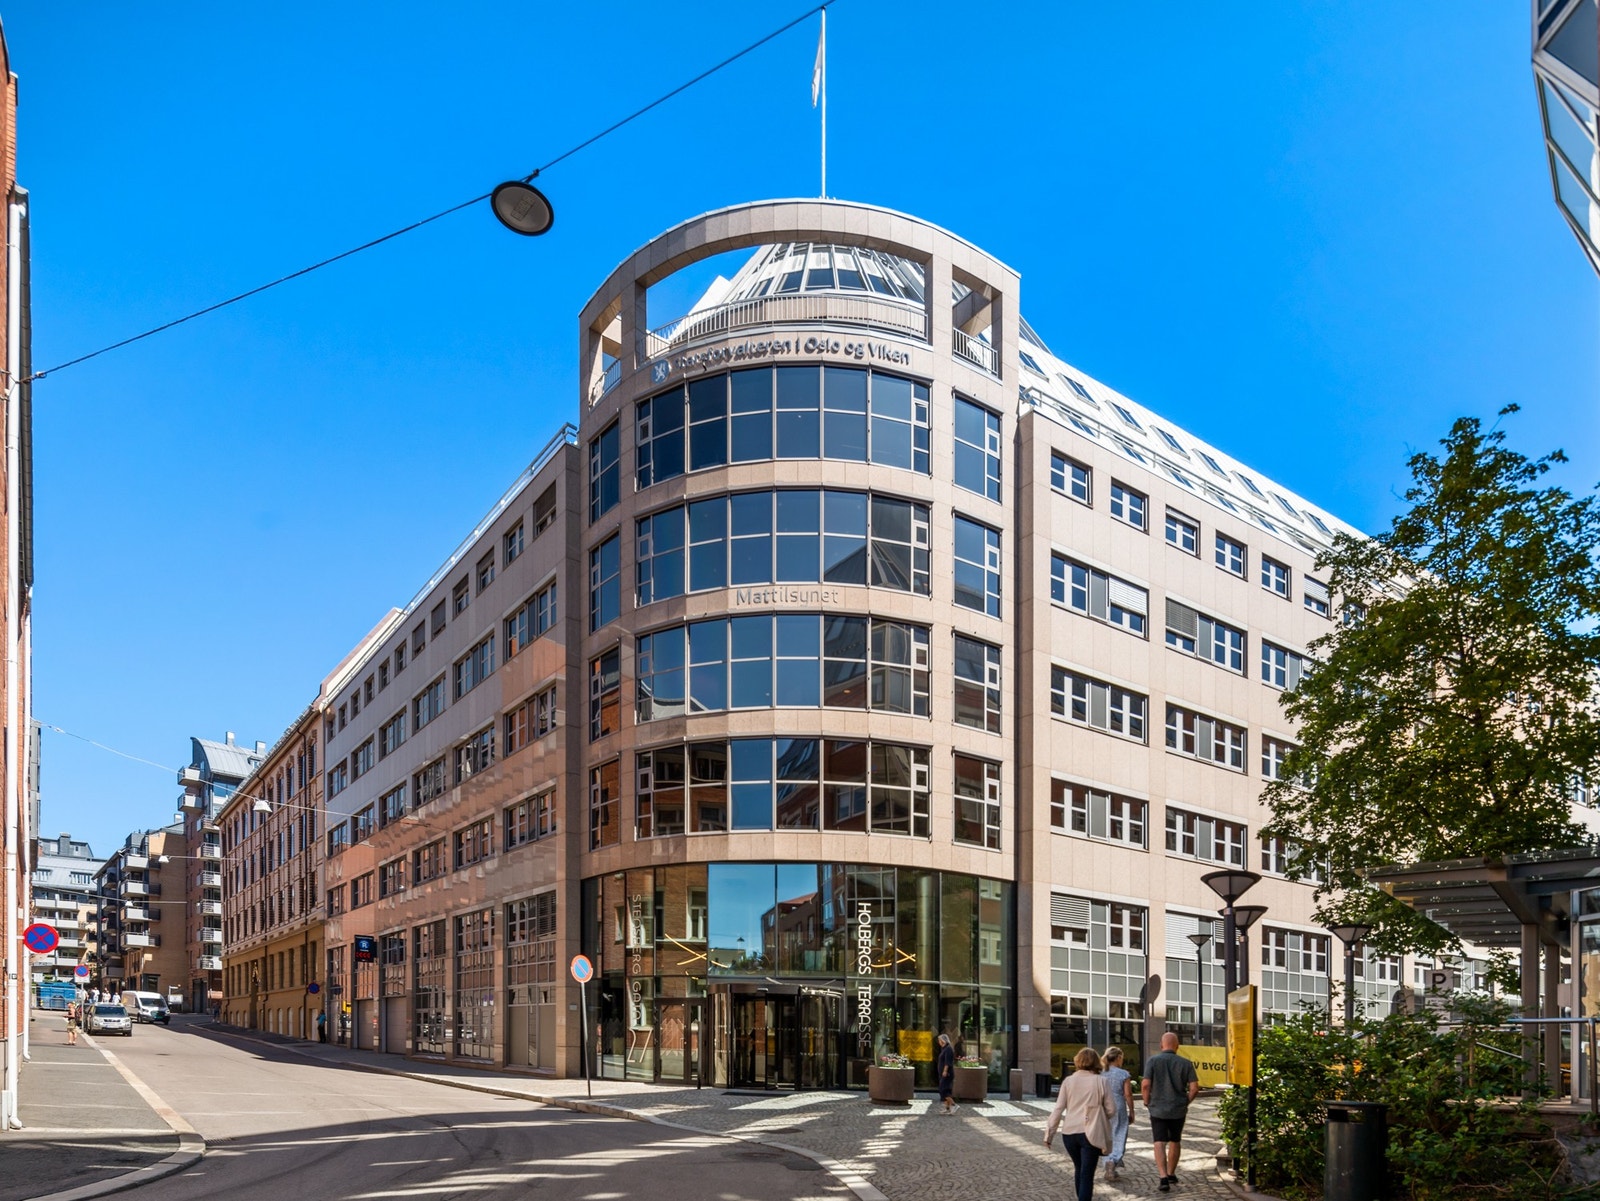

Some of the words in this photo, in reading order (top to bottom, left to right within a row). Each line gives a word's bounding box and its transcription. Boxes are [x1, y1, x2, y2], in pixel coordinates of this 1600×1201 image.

[805, 336, 840, 354] Oslo
[845, 342, 865, 359] og
[868, 342, 910, 365] Viken
[736, 586, 838, 605] Mattilsynet
[858, 902, 871, 975] HOLBERGS
[1432, 973, 1446, 988] P
[858, 984, 871, 1048] TERRASSE
[627, 1028, 652, 1063] 27
